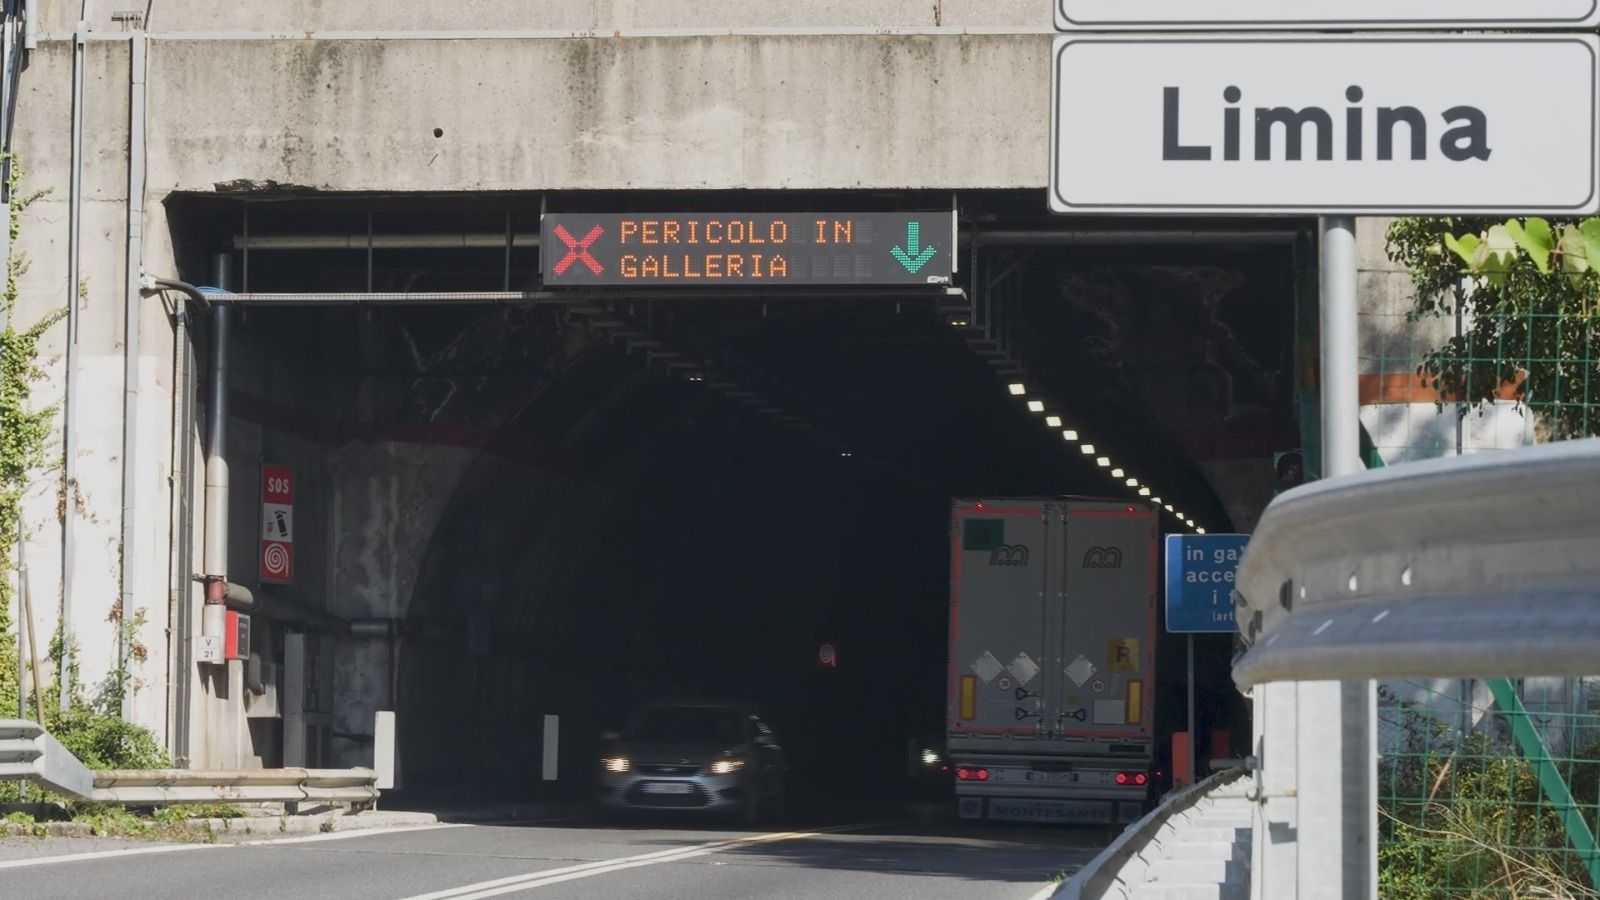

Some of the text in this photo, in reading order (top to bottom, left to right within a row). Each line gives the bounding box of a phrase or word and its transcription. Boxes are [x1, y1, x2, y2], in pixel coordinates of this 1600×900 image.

[1162, 84, 1493, 162] Limina
[620, 220, 852, 244] PERICOLO IN
[620, 254, 788, 278] GALLERIA
[268, 477, 289, 494] SOS
[1187, 545, 1204, 561] in
[1186, 567, 1237, 583] acce
[1212, 589, 1217, 604] i
